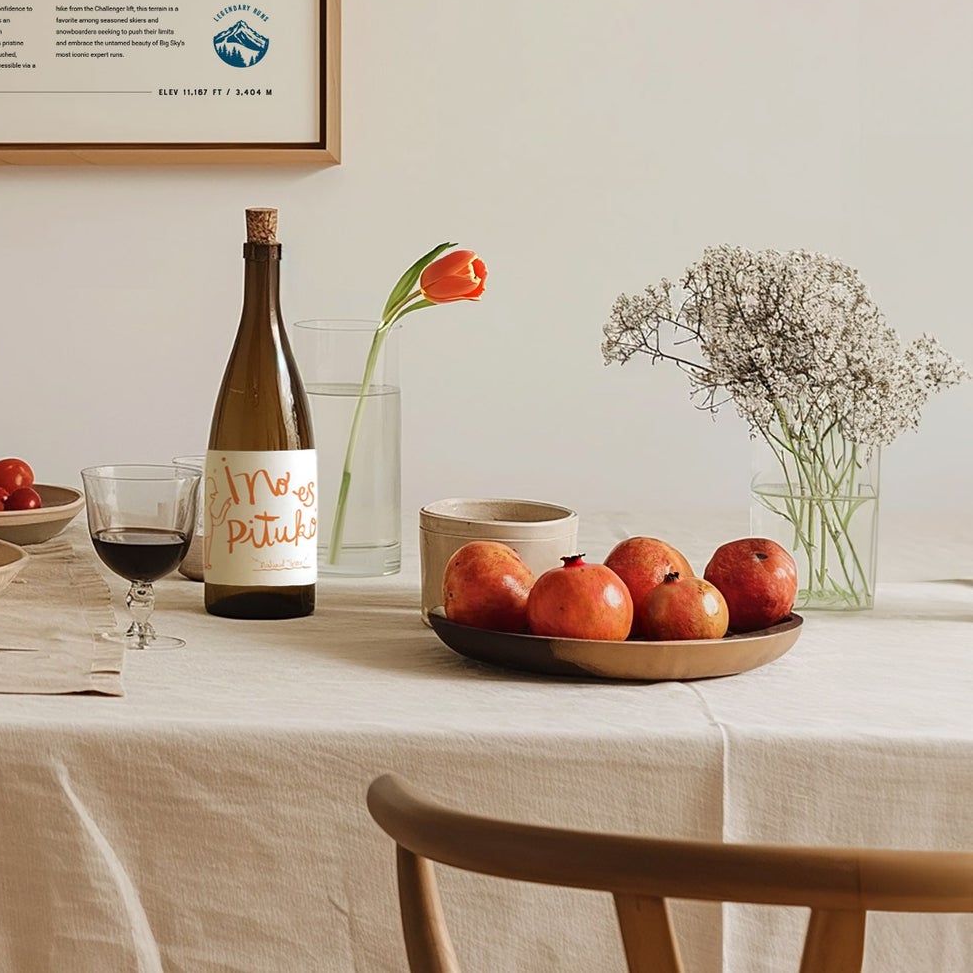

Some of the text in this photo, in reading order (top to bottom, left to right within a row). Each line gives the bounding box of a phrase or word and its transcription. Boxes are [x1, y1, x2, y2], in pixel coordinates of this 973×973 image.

[213, 4, 269, 22] LEGENDARY RUNS
[98, 28, 120, 36] seeking
[128, 28, 142, 36] push
[90, 51, 109, 59] expert
